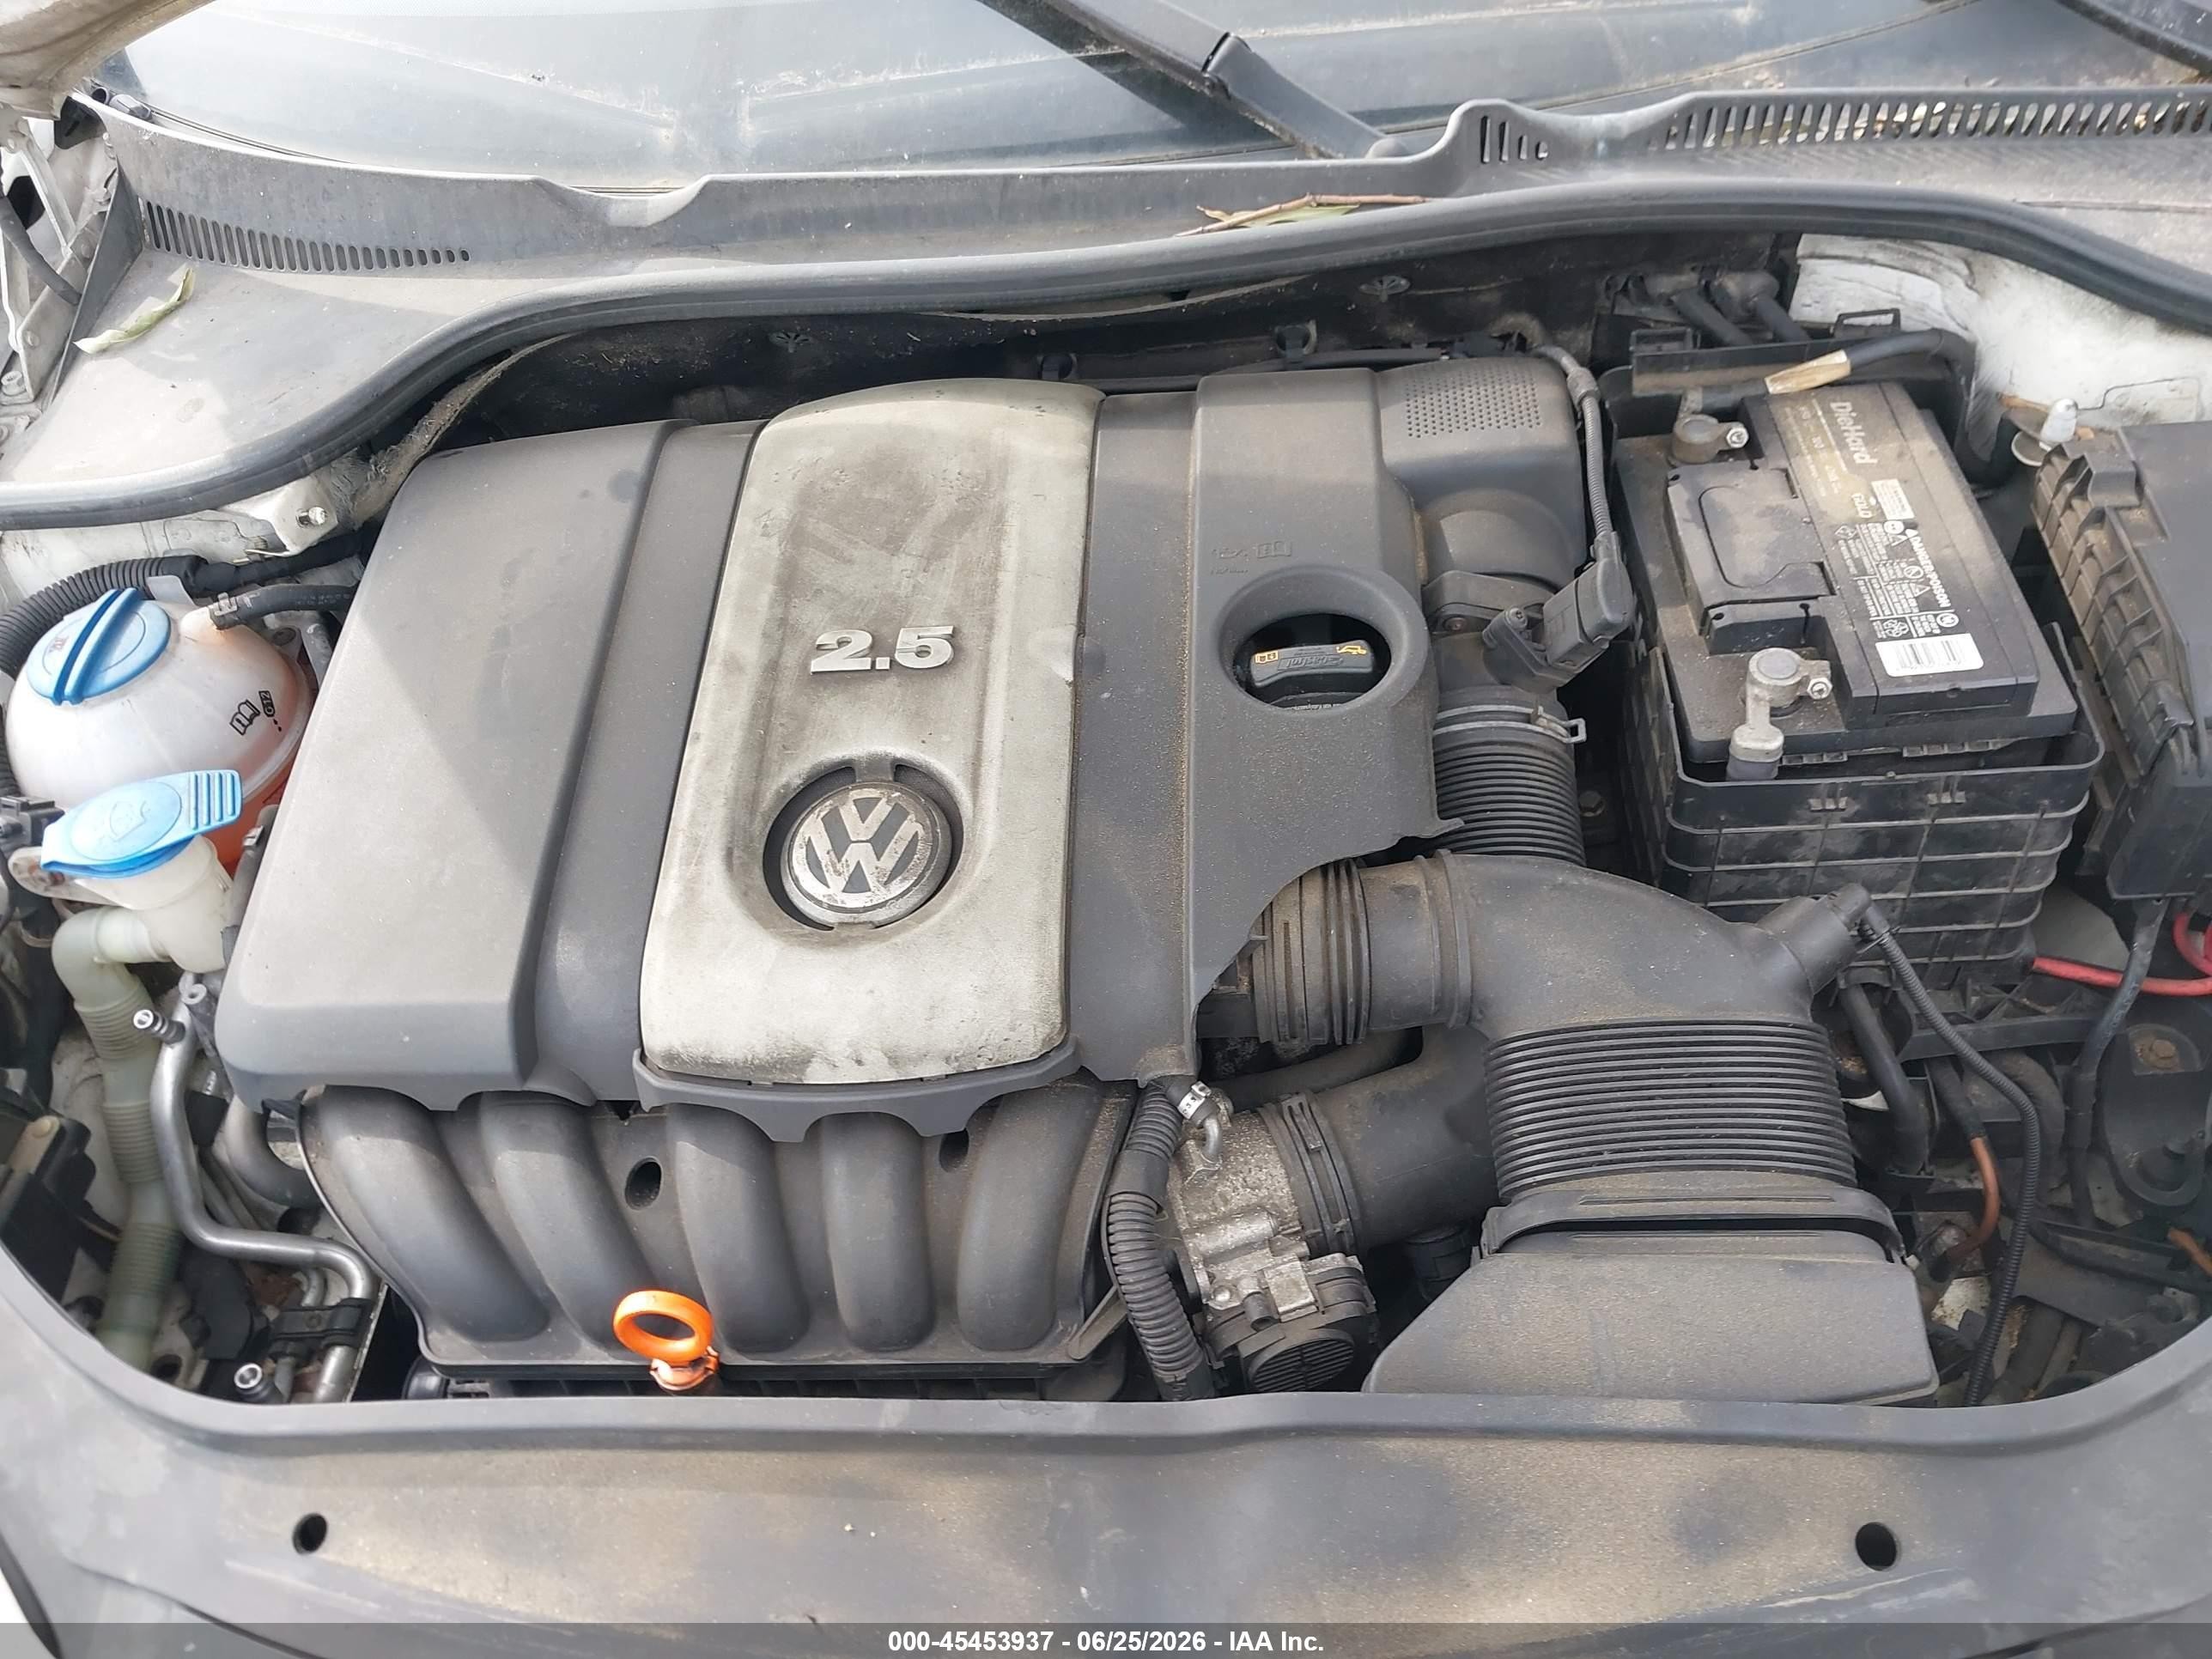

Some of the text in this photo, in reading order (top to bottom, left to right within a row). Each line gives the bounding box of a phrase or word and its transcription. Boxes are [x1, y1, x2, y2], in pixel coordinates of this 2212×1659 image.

[1830, 402, 1878, 464] DieHard
[811, 626, 955, 674] 2.5
[793, 789, 933, 908] VW
